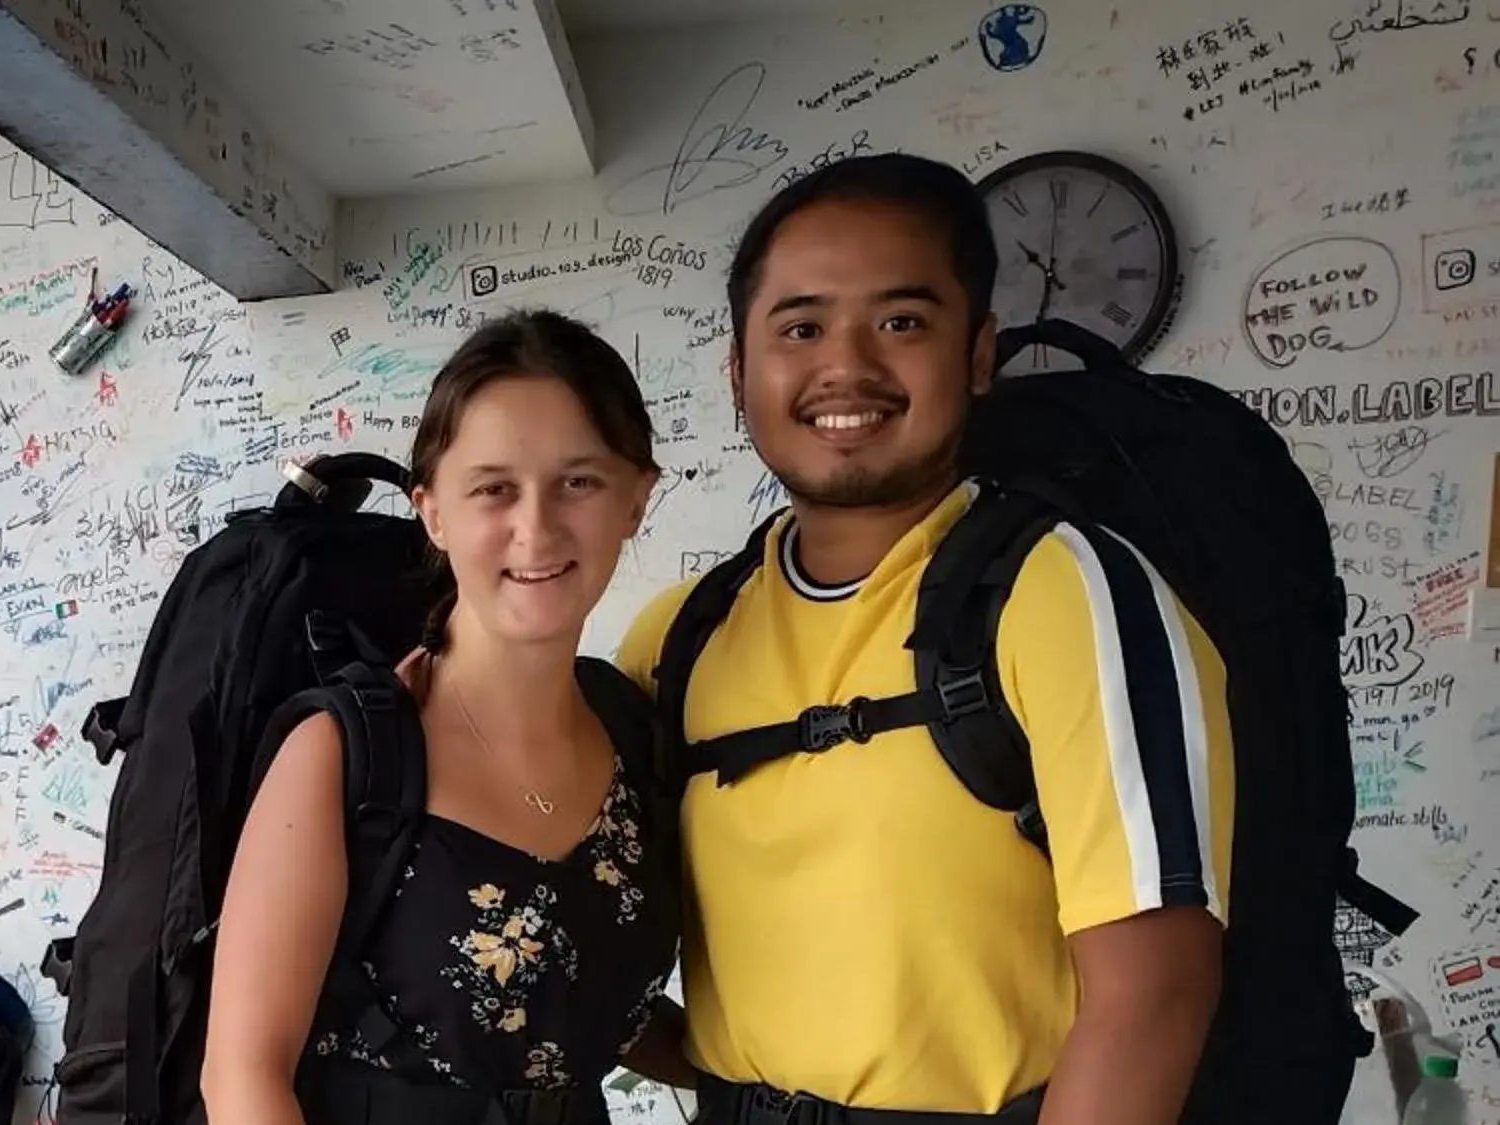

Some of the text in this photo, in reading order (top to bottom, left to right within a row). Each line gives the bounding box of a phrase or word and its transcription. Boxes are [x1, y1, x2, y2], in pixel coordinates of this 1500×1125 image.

[1261, 263, 1368, 299] FOLLOW
[1248, 303, 1297, 327] THE
[1267, 325, 1332, 359] DOG
[1230, 371, 1500, 428] HON.LABEL
